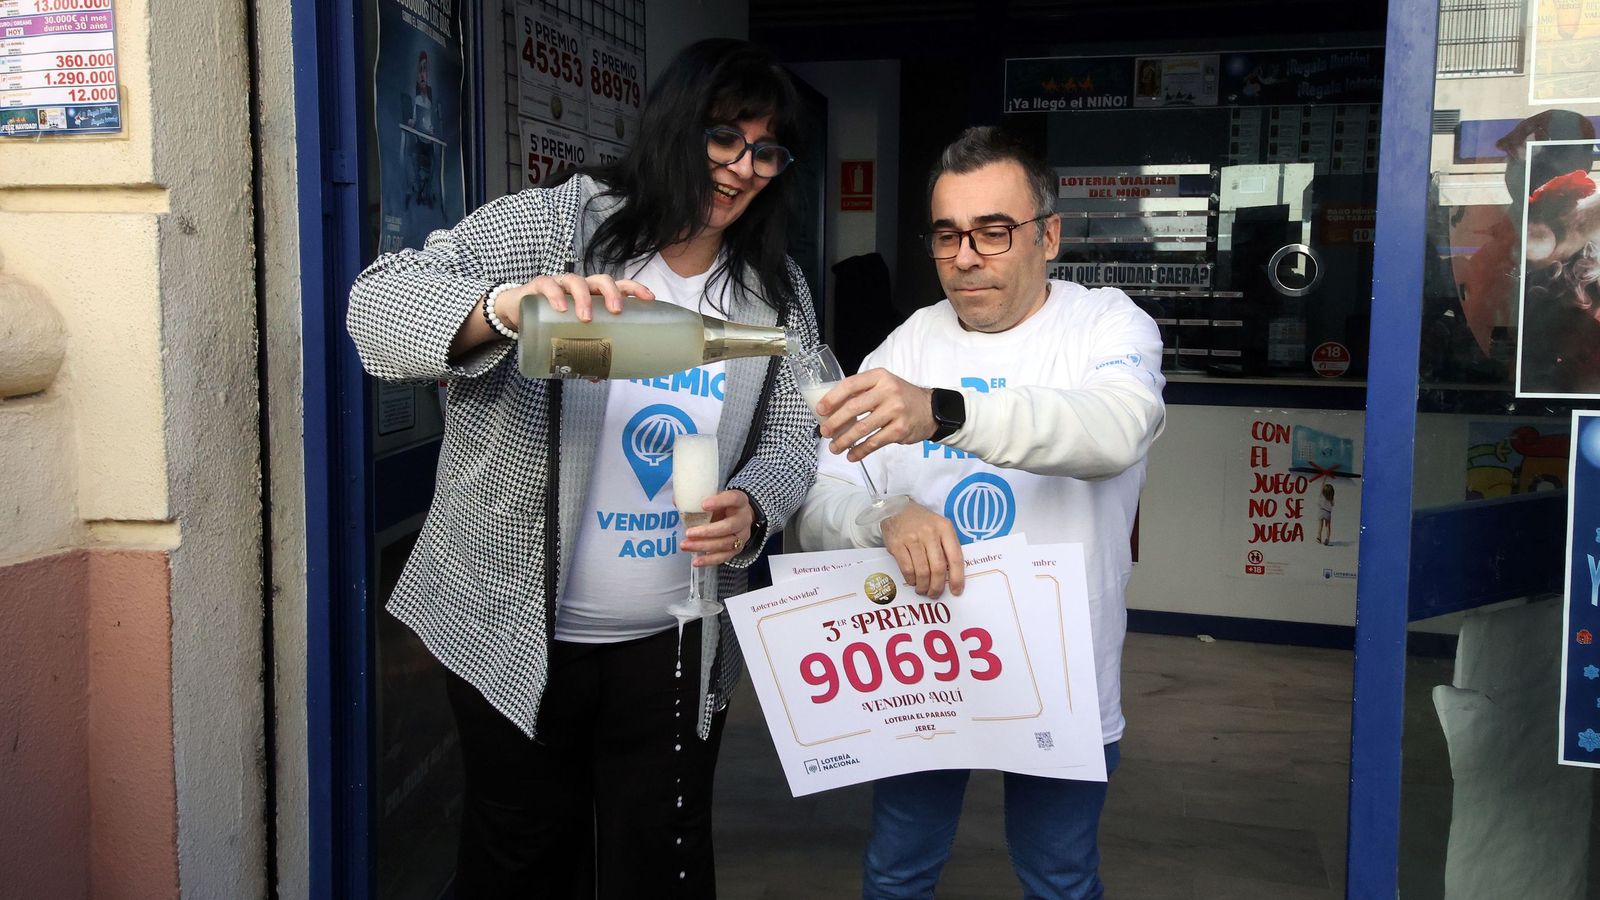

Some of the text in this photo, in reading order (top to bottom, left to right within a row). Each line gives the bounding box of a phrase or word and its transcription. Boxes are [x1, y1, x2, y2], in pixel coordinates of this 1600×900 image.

[34, 0, 110, 12] 13.000.000
[44, 14, 77, 24] 30.000€
[44, 22, 108, 32] durante 30 años
[535, 21, 578, 55] PREMIO
[56, 53, 114, 68] 360.000
[522, 37, 583, 87] 45353
[602, 53, 637, 80] PREMIO
[44, 70, 115, 85] 1.290.000
[68, 87, 116, 101] 12.000
[591, 66, 640, 108] 88979
[1008, 94, 1127, 111] ¡Ya llegó el NIÑO!
[542, 137, 585, 163] PREMIO
[1060, 176, 1176, 187] LOTERÍA VIAJERA
[1088, 187, 1151, 198] DEL NIÑO
[1355, 230, 1369, 240] 10
[1076, 263, 1101, 285] QUÉ
[1104, 266, 1154, 284] CIUDAD
[1157, 263, 1209, 285] CAERÁ?
[1320, 346, 1342, 358] +18
[1251, 420, 1291, 444] CON
[1250, 446, 1272, 468] EL
[1250, 472, 1308, 495] JUEGO
[1249, 497, 1305, 519] NO SE
[597, 510, 680, 531] VENDID
[1248, 522, 1304, 543] JUEGA
[618, 531, 677, 558] AQUÍ
[1248, 566, 1262, 574] +18
[779, 597, 788, 605] de
[788, 587, 819, 601] Navidad
[851, 602, 951, 634] PREMIO
[799, 627, 1003, 705] 90693
[862, 688, 964, 713] VENDIDO AQUÍ
[884, 714, 915, 725] LOTERIA
[925, 711, 957, 719] PARAISO
[914, 724, 936, 732] JEREZ
[820, 753, 851, 765] LOTERÍA
[823, 757, 860, 771] NACIONAL
